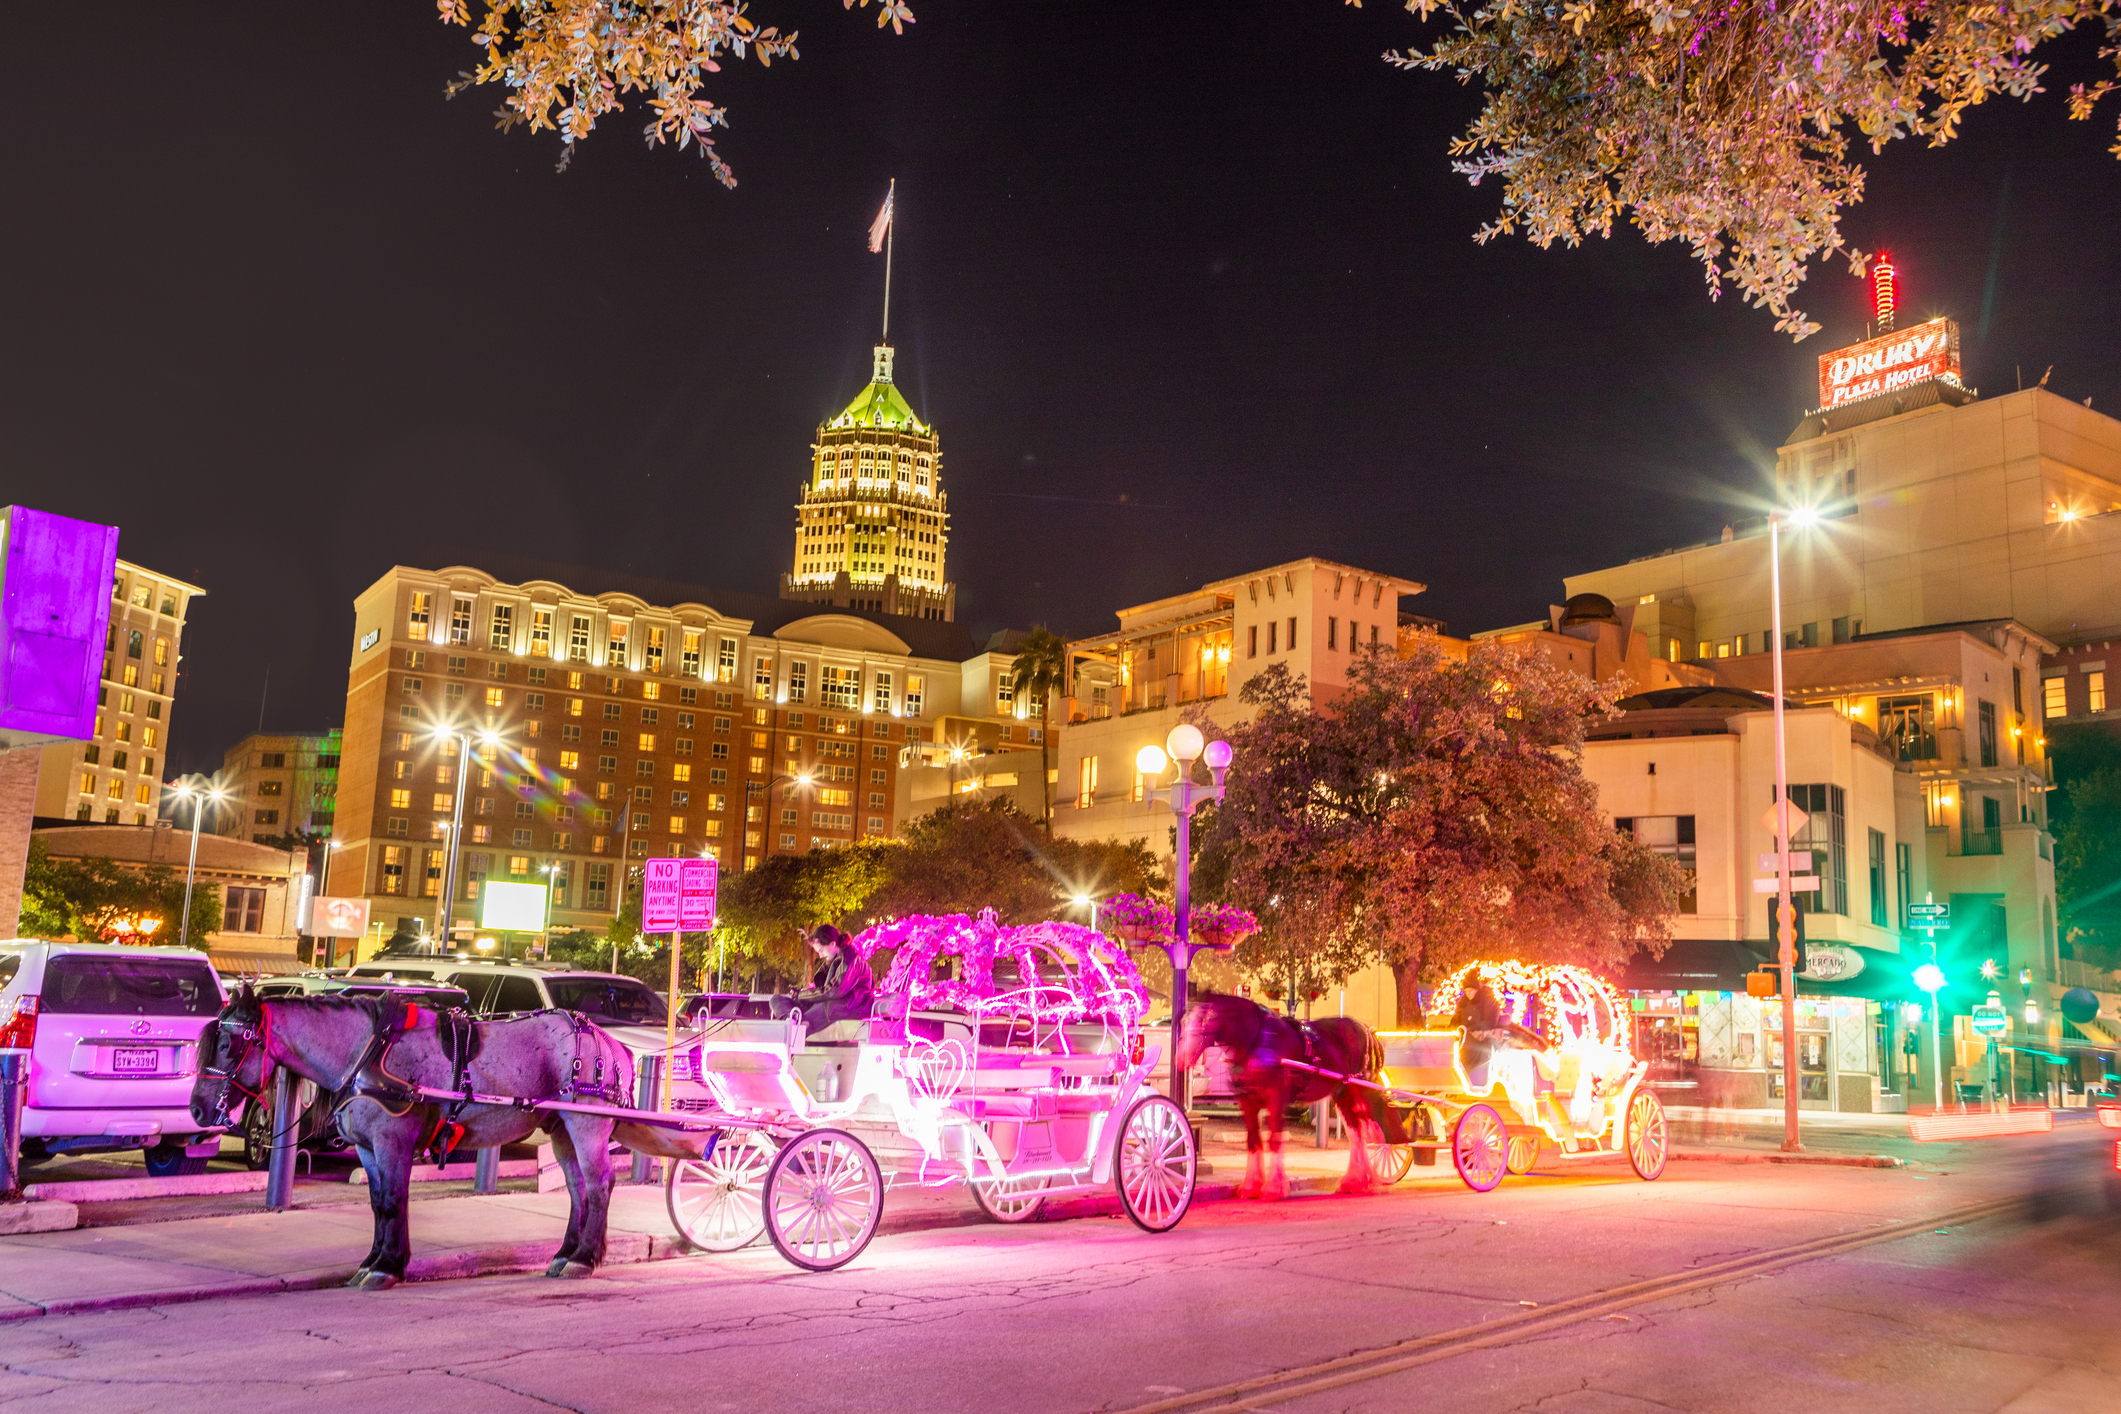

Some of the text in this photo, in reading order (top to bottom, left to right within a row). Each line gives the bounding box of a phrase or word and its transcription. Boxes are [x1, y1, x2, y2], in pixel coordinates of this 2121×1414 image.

[1829, 335, 1936, 386] DRURY
[1832, 363, 1931, 404] PLAZA HOTEL
[655, 864, 673, 877] NO
[684, 869, 714, 878] COMMERCIAL
[648, 880, 678, 893] PARKING
[683, 879, 701, 888] LOADING
[648, 896, 676, 906] ANYTIME
[684, 899, 695, 907] 30
[1806, 957, 1847, 967] MERCADO
